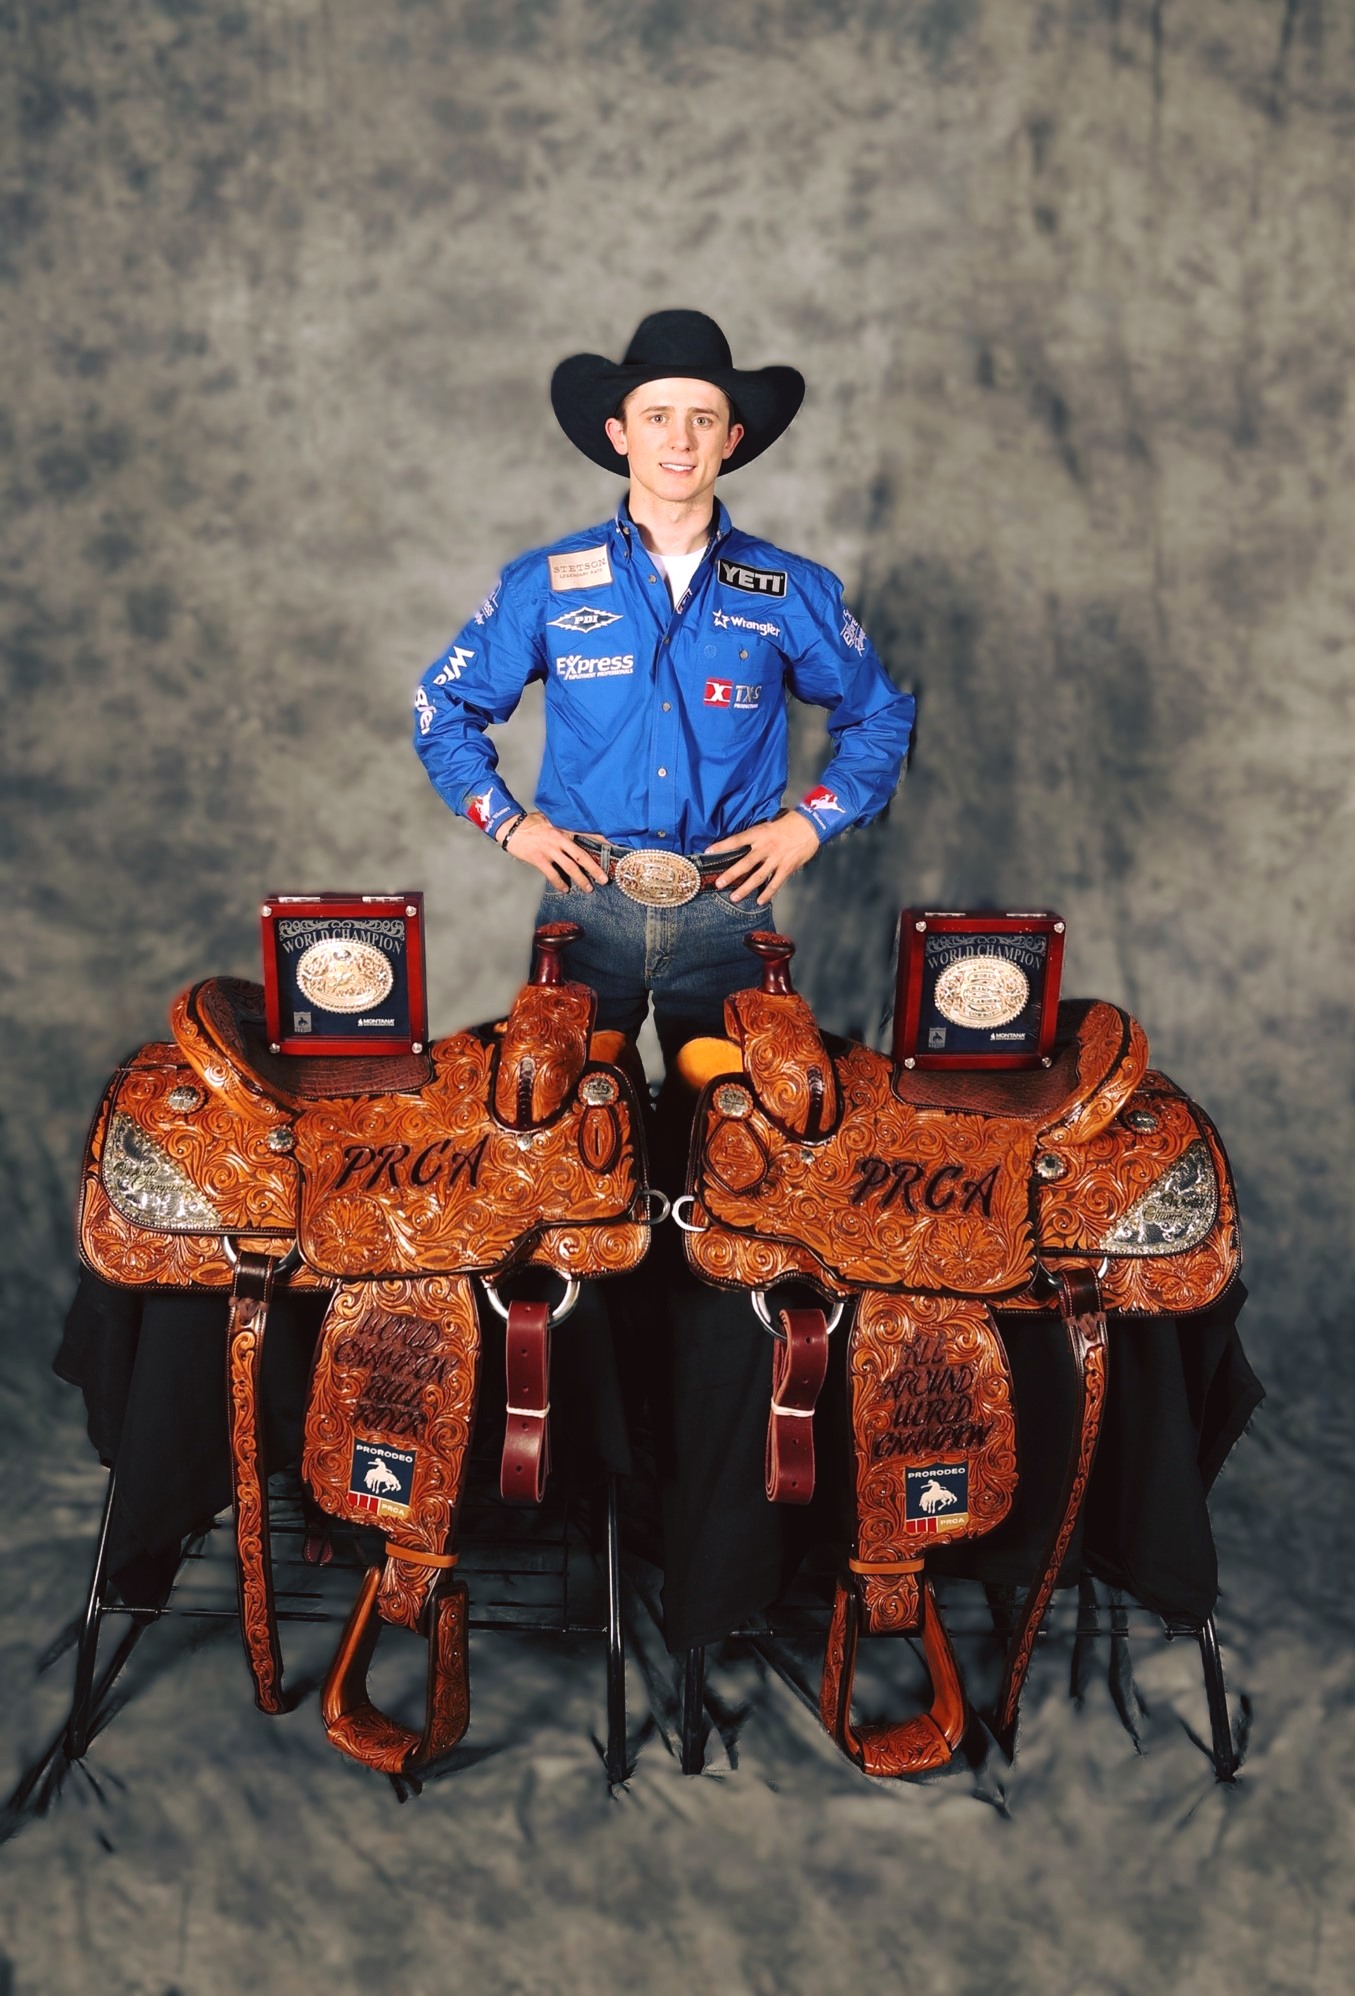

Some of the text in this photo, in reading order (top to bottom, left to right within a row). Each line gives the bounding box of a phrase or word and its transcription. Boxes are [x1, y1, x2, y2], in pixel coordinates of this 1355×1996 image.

[553, 558, 607, 573] STETSON
[721, 562, 781, 593] YETI
[730, 616, 781, 637] Wrangler
[283, 929, 403, 955] WORLD CHAMPION
[927, 946, 975, 970] WORLD
[977, 944, 1043, 970] CHAMPION
[335, 1134, 490, 1190] PRCA
[852, 1158, 1001, 1218] PRCA
[359, 1311, 441, 1349] WORLD
[356, 1444, 413, 1464] PRORODEO
[908, 1467, 966, 1479] PRORODEO
[381, 1503, 405, 1516] PRCA
[940, 1518, 965, 1526] PRCA
